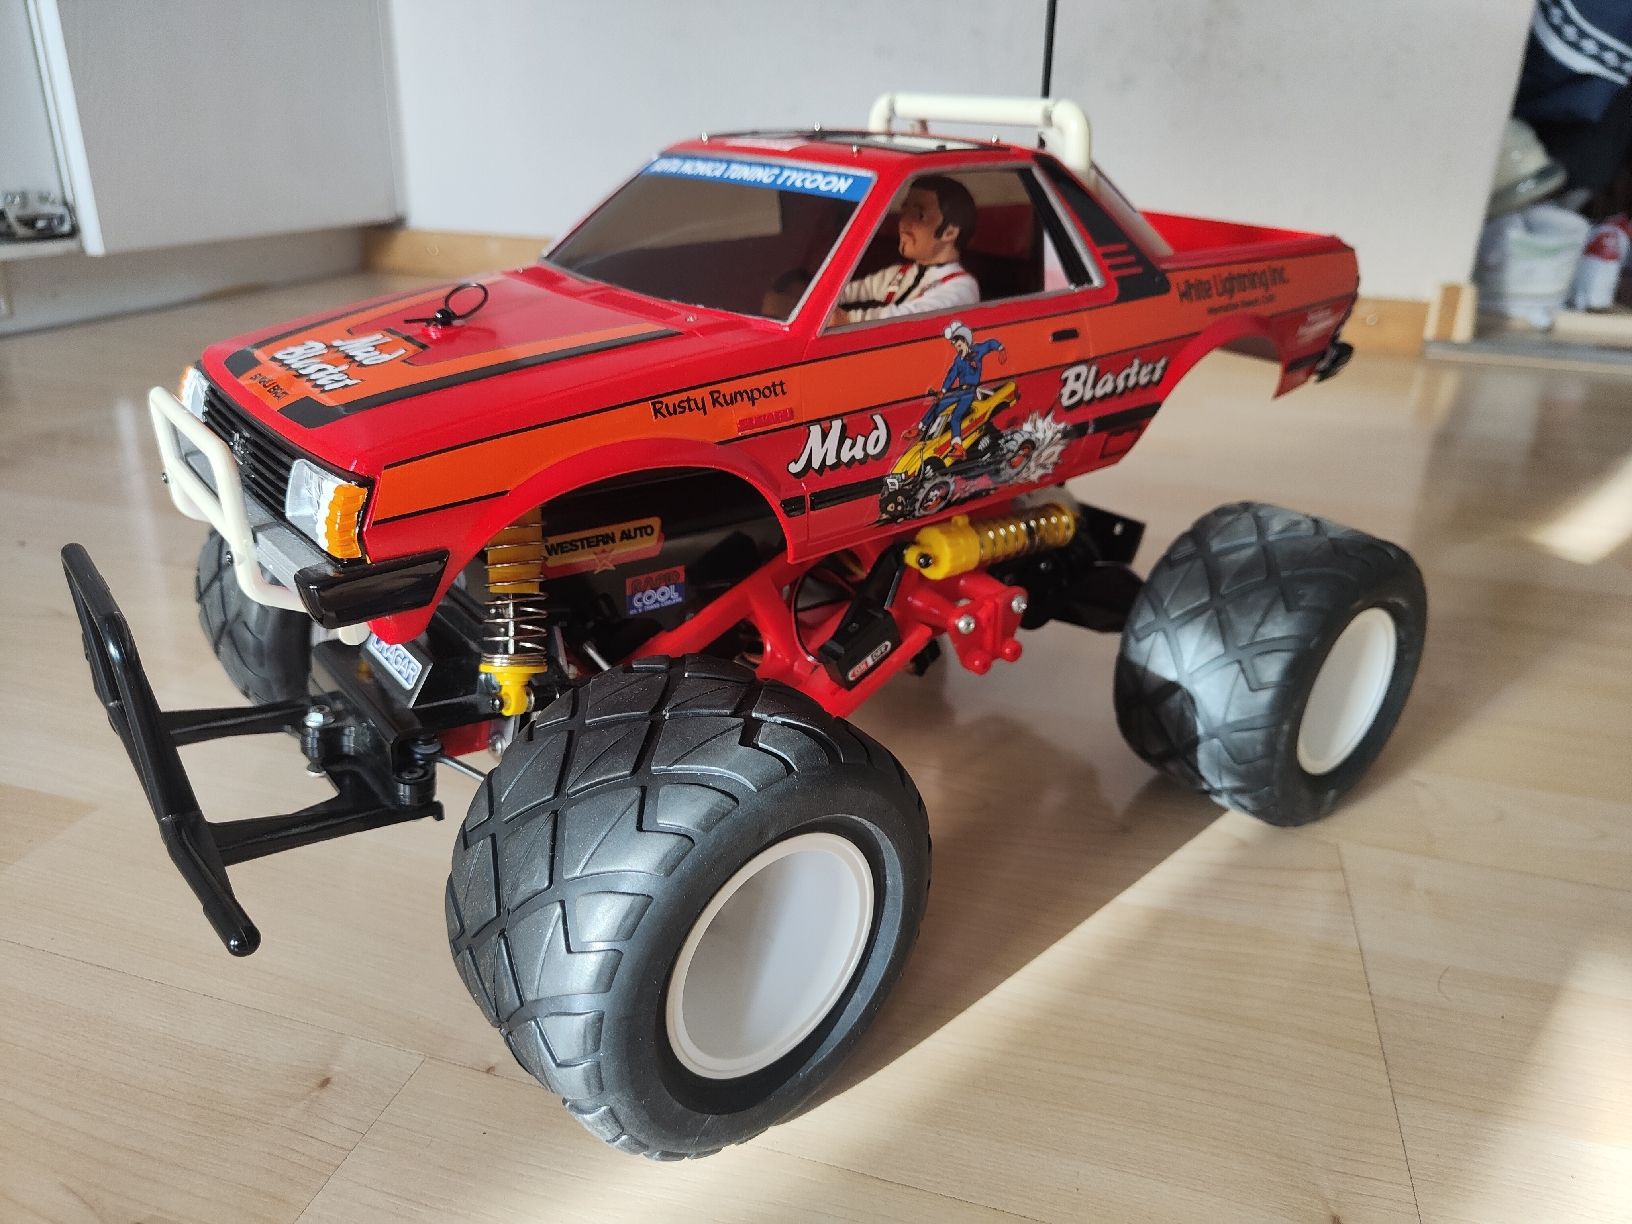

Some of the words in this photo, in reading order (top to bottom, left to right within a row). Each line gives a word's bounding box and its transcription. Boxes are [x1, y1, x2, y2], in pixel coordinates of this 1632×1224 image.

[725, 163, 781, 185] TUNING
[777, 169, 854, 195] TYCOON
[271, 340, 365, 393] Blaster
[1059, 356, 1169, 408] Blaster
[650, 400, 707, 420] Rusty
[709, 380, 788, 406] Rumpott
[787, 413, 890, 477] Mud
[545, 531, 616, 556] WESTERN
[620, 524, 654, 542] AUTO
[633, 584, 679, 608] COOL
